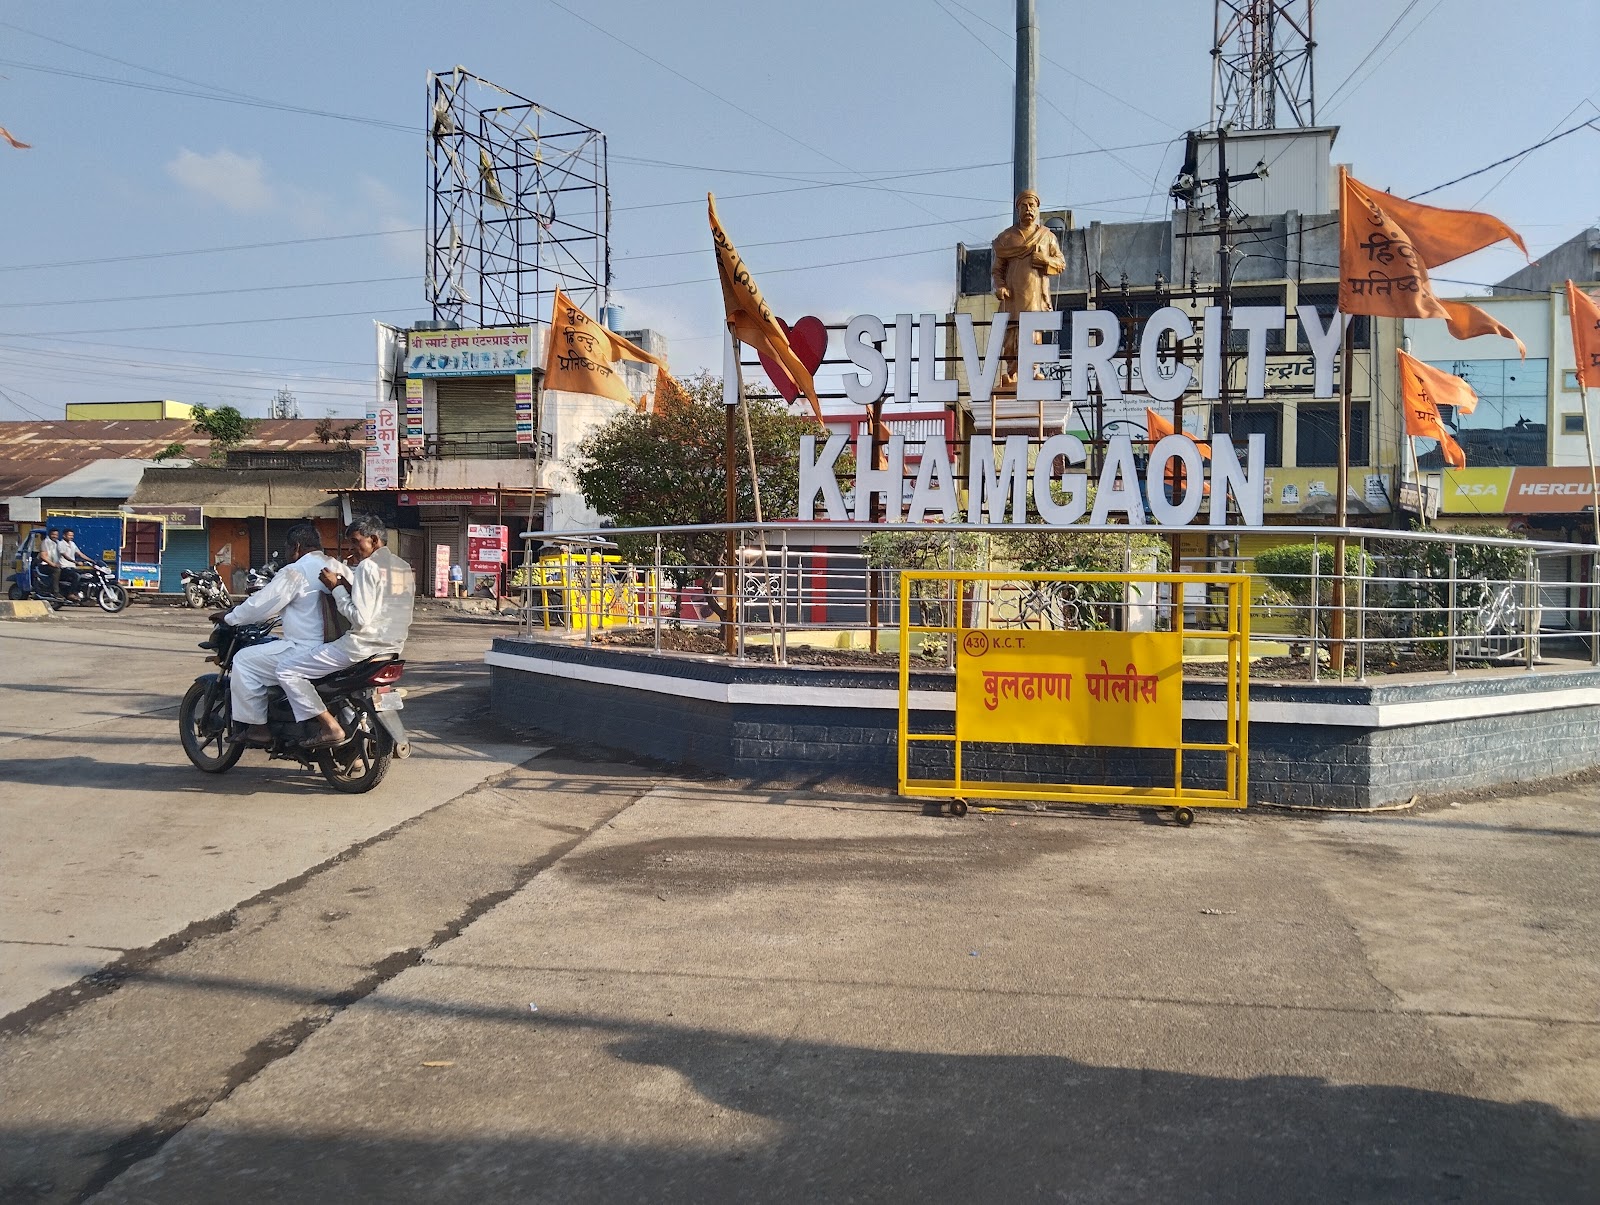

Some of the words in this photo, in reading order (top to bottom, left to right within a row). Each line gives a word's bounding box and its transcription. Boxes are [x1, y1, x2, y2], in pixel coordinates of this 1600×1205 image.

[411, 335, 423, 349] श्री
[425, 333, 448, 348] स्मार्ट
[450, 334, 470, 349] होम
[557, 349, 614, 378] प्रतिष्ठान
[797, 432, 1267, 526] KHAMGAON
[1455, 483, 1498, 496] BSA
[478, 526, 495, 534] ATM
[965, 637, 986, 649] 430
[993, 637, 1026, 649] K.C.T.
[982, 670, 1073, 711] बुलढाणा
[1085, 659, 1160, 704] पोलीस
